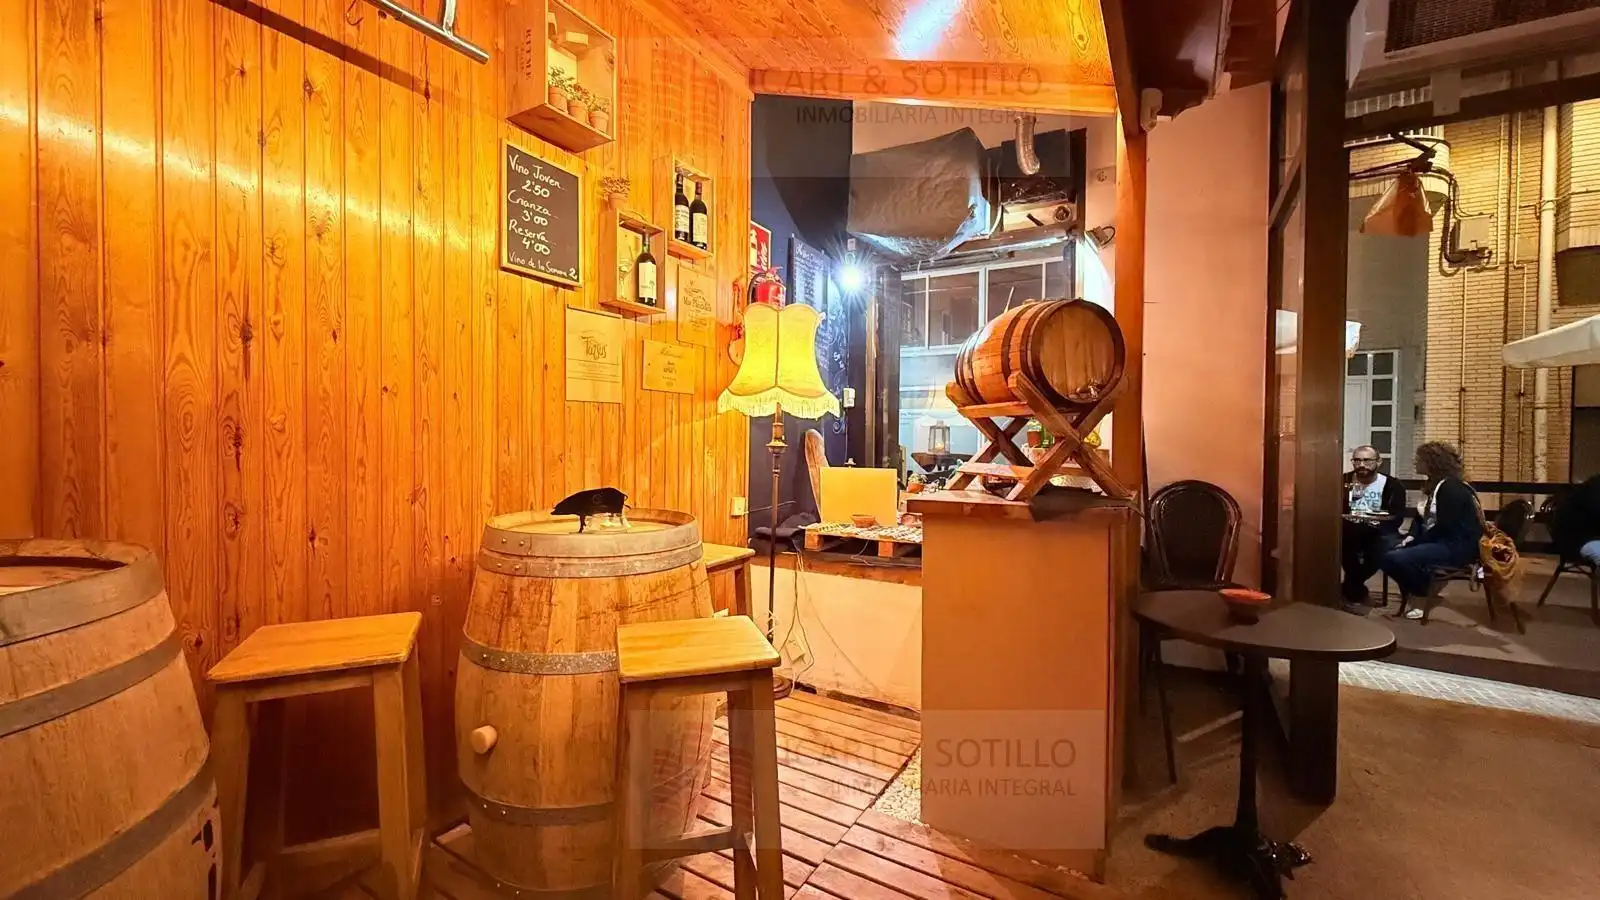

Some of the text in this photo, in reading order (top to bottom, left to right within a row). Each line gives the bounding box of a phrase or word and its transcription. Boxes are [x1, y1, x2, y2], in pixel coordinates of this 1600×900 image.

[508, 154, 561, 189] Vino Joven
[521, 179, 550, 198] 2'50
[507, 189, 552, 217] Crianza
[522, 209, 548, 226] 3'00
[508, 218, 549, 243] Reserva
[522, 236, 551, 256] 4'00
[508, 251, 526, 265] Vino
[528, 257, 536, 268] de
